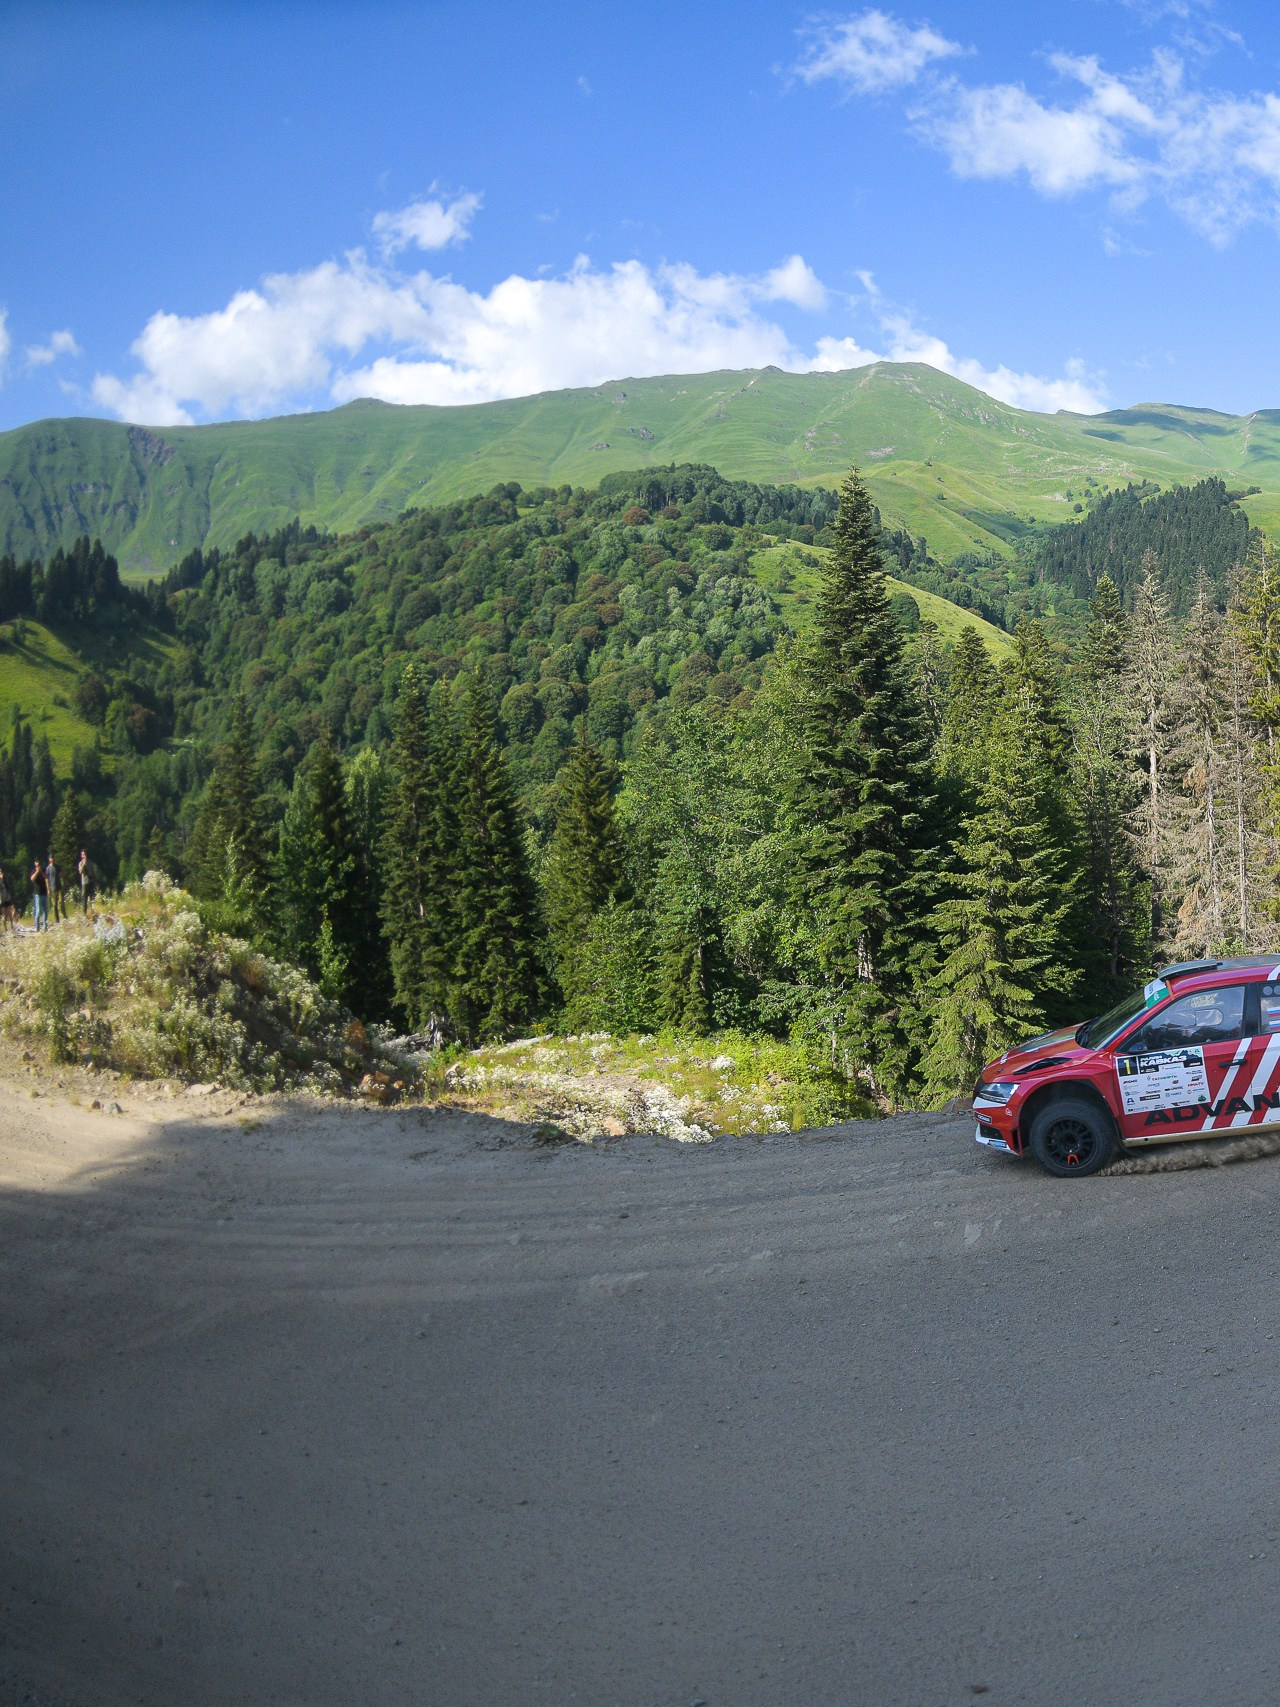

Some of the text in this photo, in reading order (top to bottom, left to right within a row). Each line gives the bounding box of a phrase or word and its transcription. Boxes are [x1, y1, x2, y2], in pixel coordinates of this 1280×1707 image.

[1123, 1059, 1131, 1075] 1
[1140, 1055, 1188, 1068] КАВКАЗ
[1144, 1092, 1280, 1126] ADVAN
